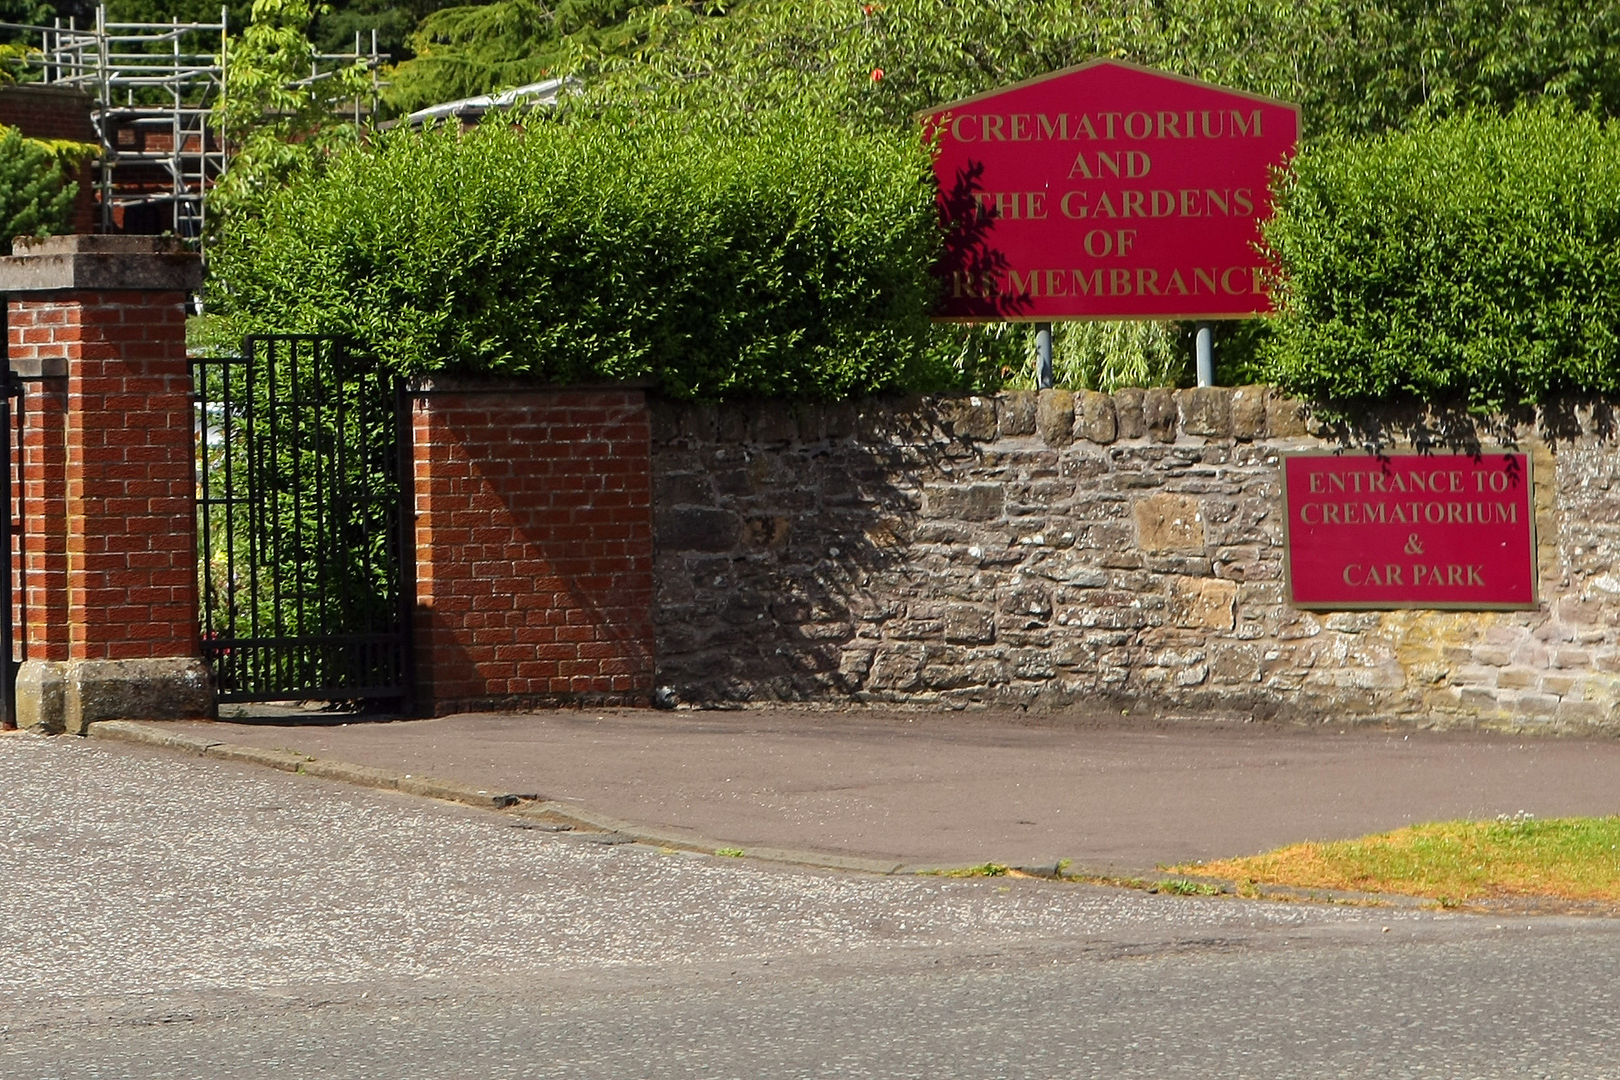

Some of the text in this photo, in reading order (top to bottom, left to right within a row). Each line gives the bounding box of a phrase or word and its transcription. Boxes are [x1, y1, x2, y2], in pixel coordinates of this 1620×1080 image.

[952, 110, 1263, 141] CREMATORIUM
[1068, 151, 1151, 180] AND
[974, 189, 1254, 219] THE GARDENS
[1083, 229, 1137, 258] OF
[1309, 471, 1509, 494] ENTRANCE TO
[1300, 502, 1517, 524] CREMATORIUM
[1403, 533, 1424, 555] &
[1343, 564, 1485, 586] CAR PARK
